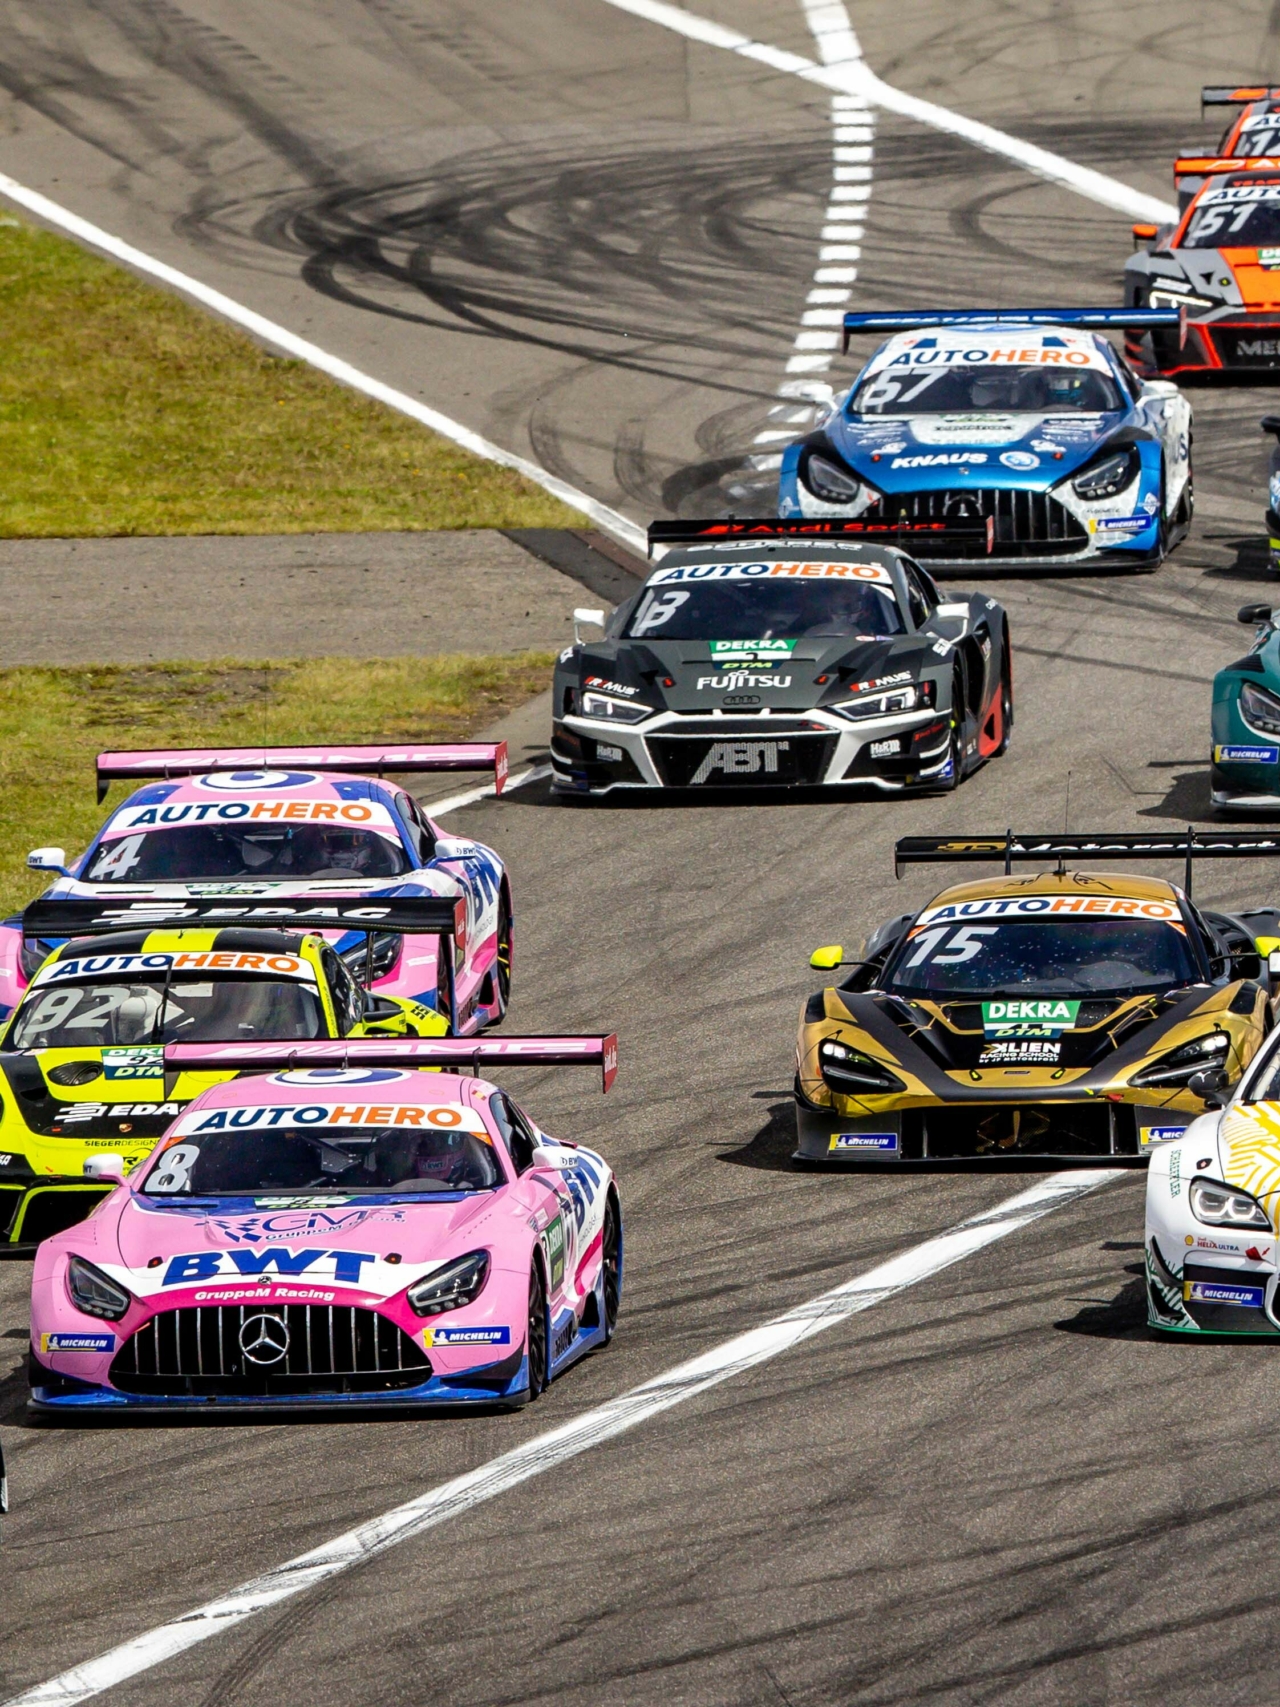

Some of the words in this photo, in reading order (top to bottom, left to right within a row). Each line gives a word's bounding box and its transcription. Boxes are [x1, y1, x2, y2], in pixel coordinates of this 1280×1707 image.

[1193, 203, 1258, 238] 51
[888, 350, 1090, 367] AUTOHERO
[890, 452, 988, 469] KNAUS
[659, 563, 881, 583] AUTOHERO
[715, 640, 788, 651] DEKRA
[697, 672, 792, 691] FUJITSU
[690, 741, 780, 785] ABT
[1229, 750, 1271, 760] MICHELIN
[128, 802, 373, 828] AUTOHERO
[89, 833, 147, 879] 4
[201, 906, 392, 919] EDAG
[929, 899, 1173, 922] AUTOHERO
[906, 926, 999, 968] 15
[51, 953, 301, 980] AUTOHERO
[22, 988, 131, 1034] 92
[988, 1001, 1071, 1019] DEKRA
[995, 1028, 1052, 1037] DTM
[108, 1103, 188, 1116] EDA
[196, 1105, 462, 1132] AUTOHERO
[847, 1138, 890, 1147] MICHELIN
[145, 1144, 200, 1193] 8
[265, 1223, 343, 1241] GruppeM
[161, 1248, 376, 1287] BWT
[194, 1287, 270, 1301] GruppeM
[274, 1287, 336, 1301] Racing
[1203, 1290, 1254, 1301] MICHELIN
[60, 1338, 112, 1347] MICHELIN
[449, 1330, 503, 1342] MICHELIN
